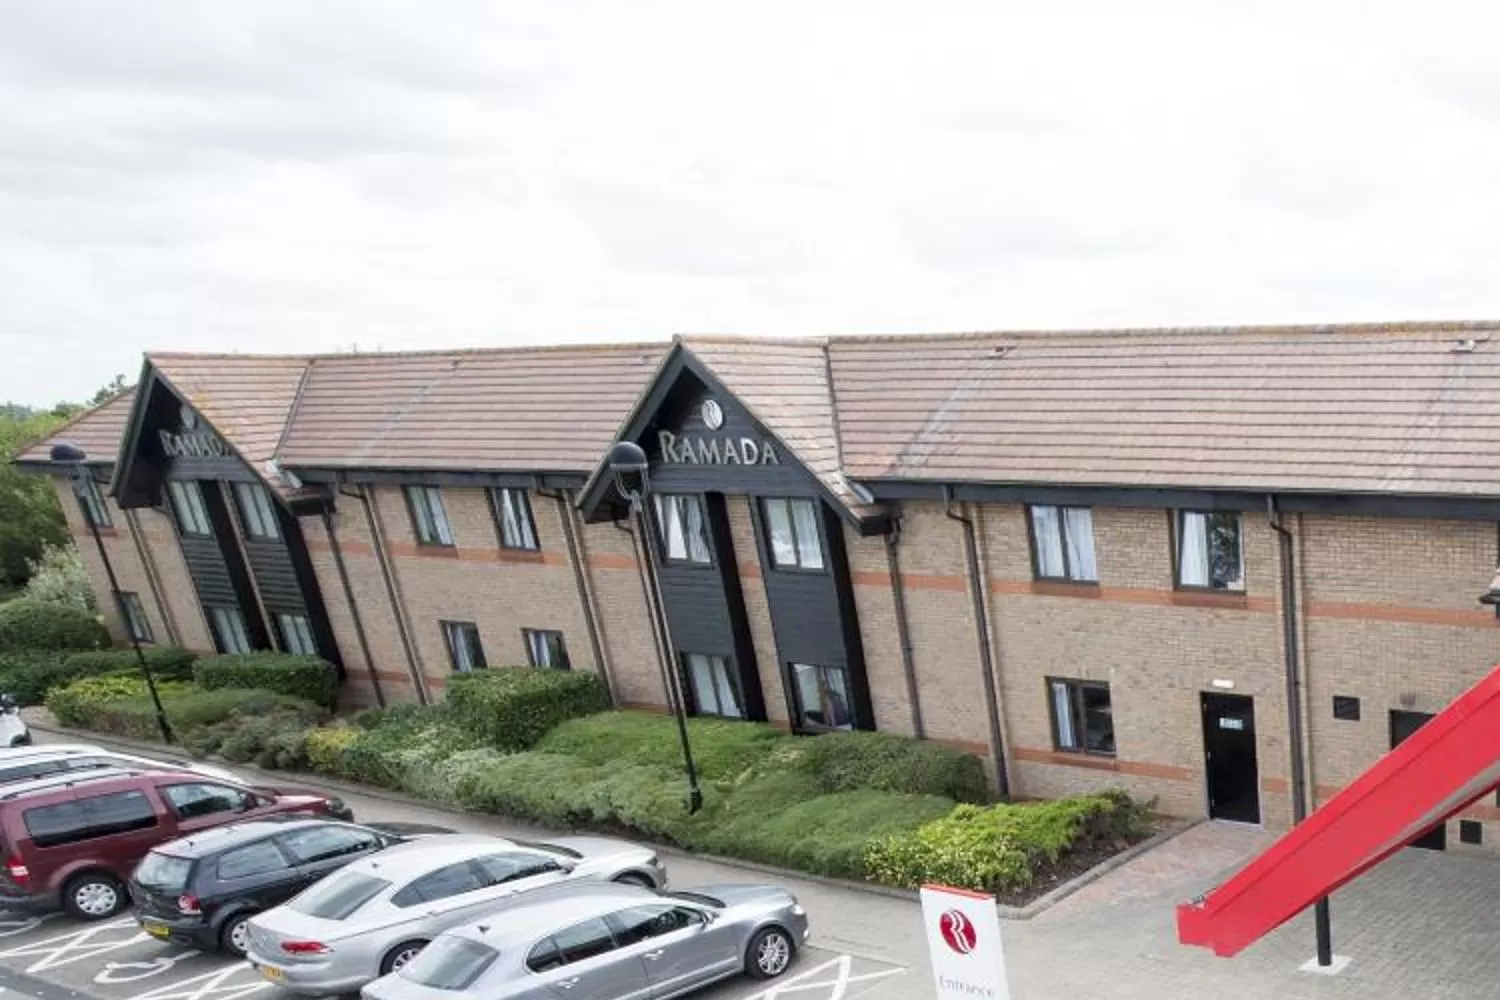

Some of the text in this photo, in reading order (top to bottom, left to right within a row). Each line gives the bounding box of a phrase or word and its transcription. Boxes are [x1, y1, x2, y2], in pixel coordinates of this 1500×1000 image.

[158, 428, 229, 458] RAMAD
[658, 429, 779, 465] RAMADA
[938, 974, 996, 999] Entrance
